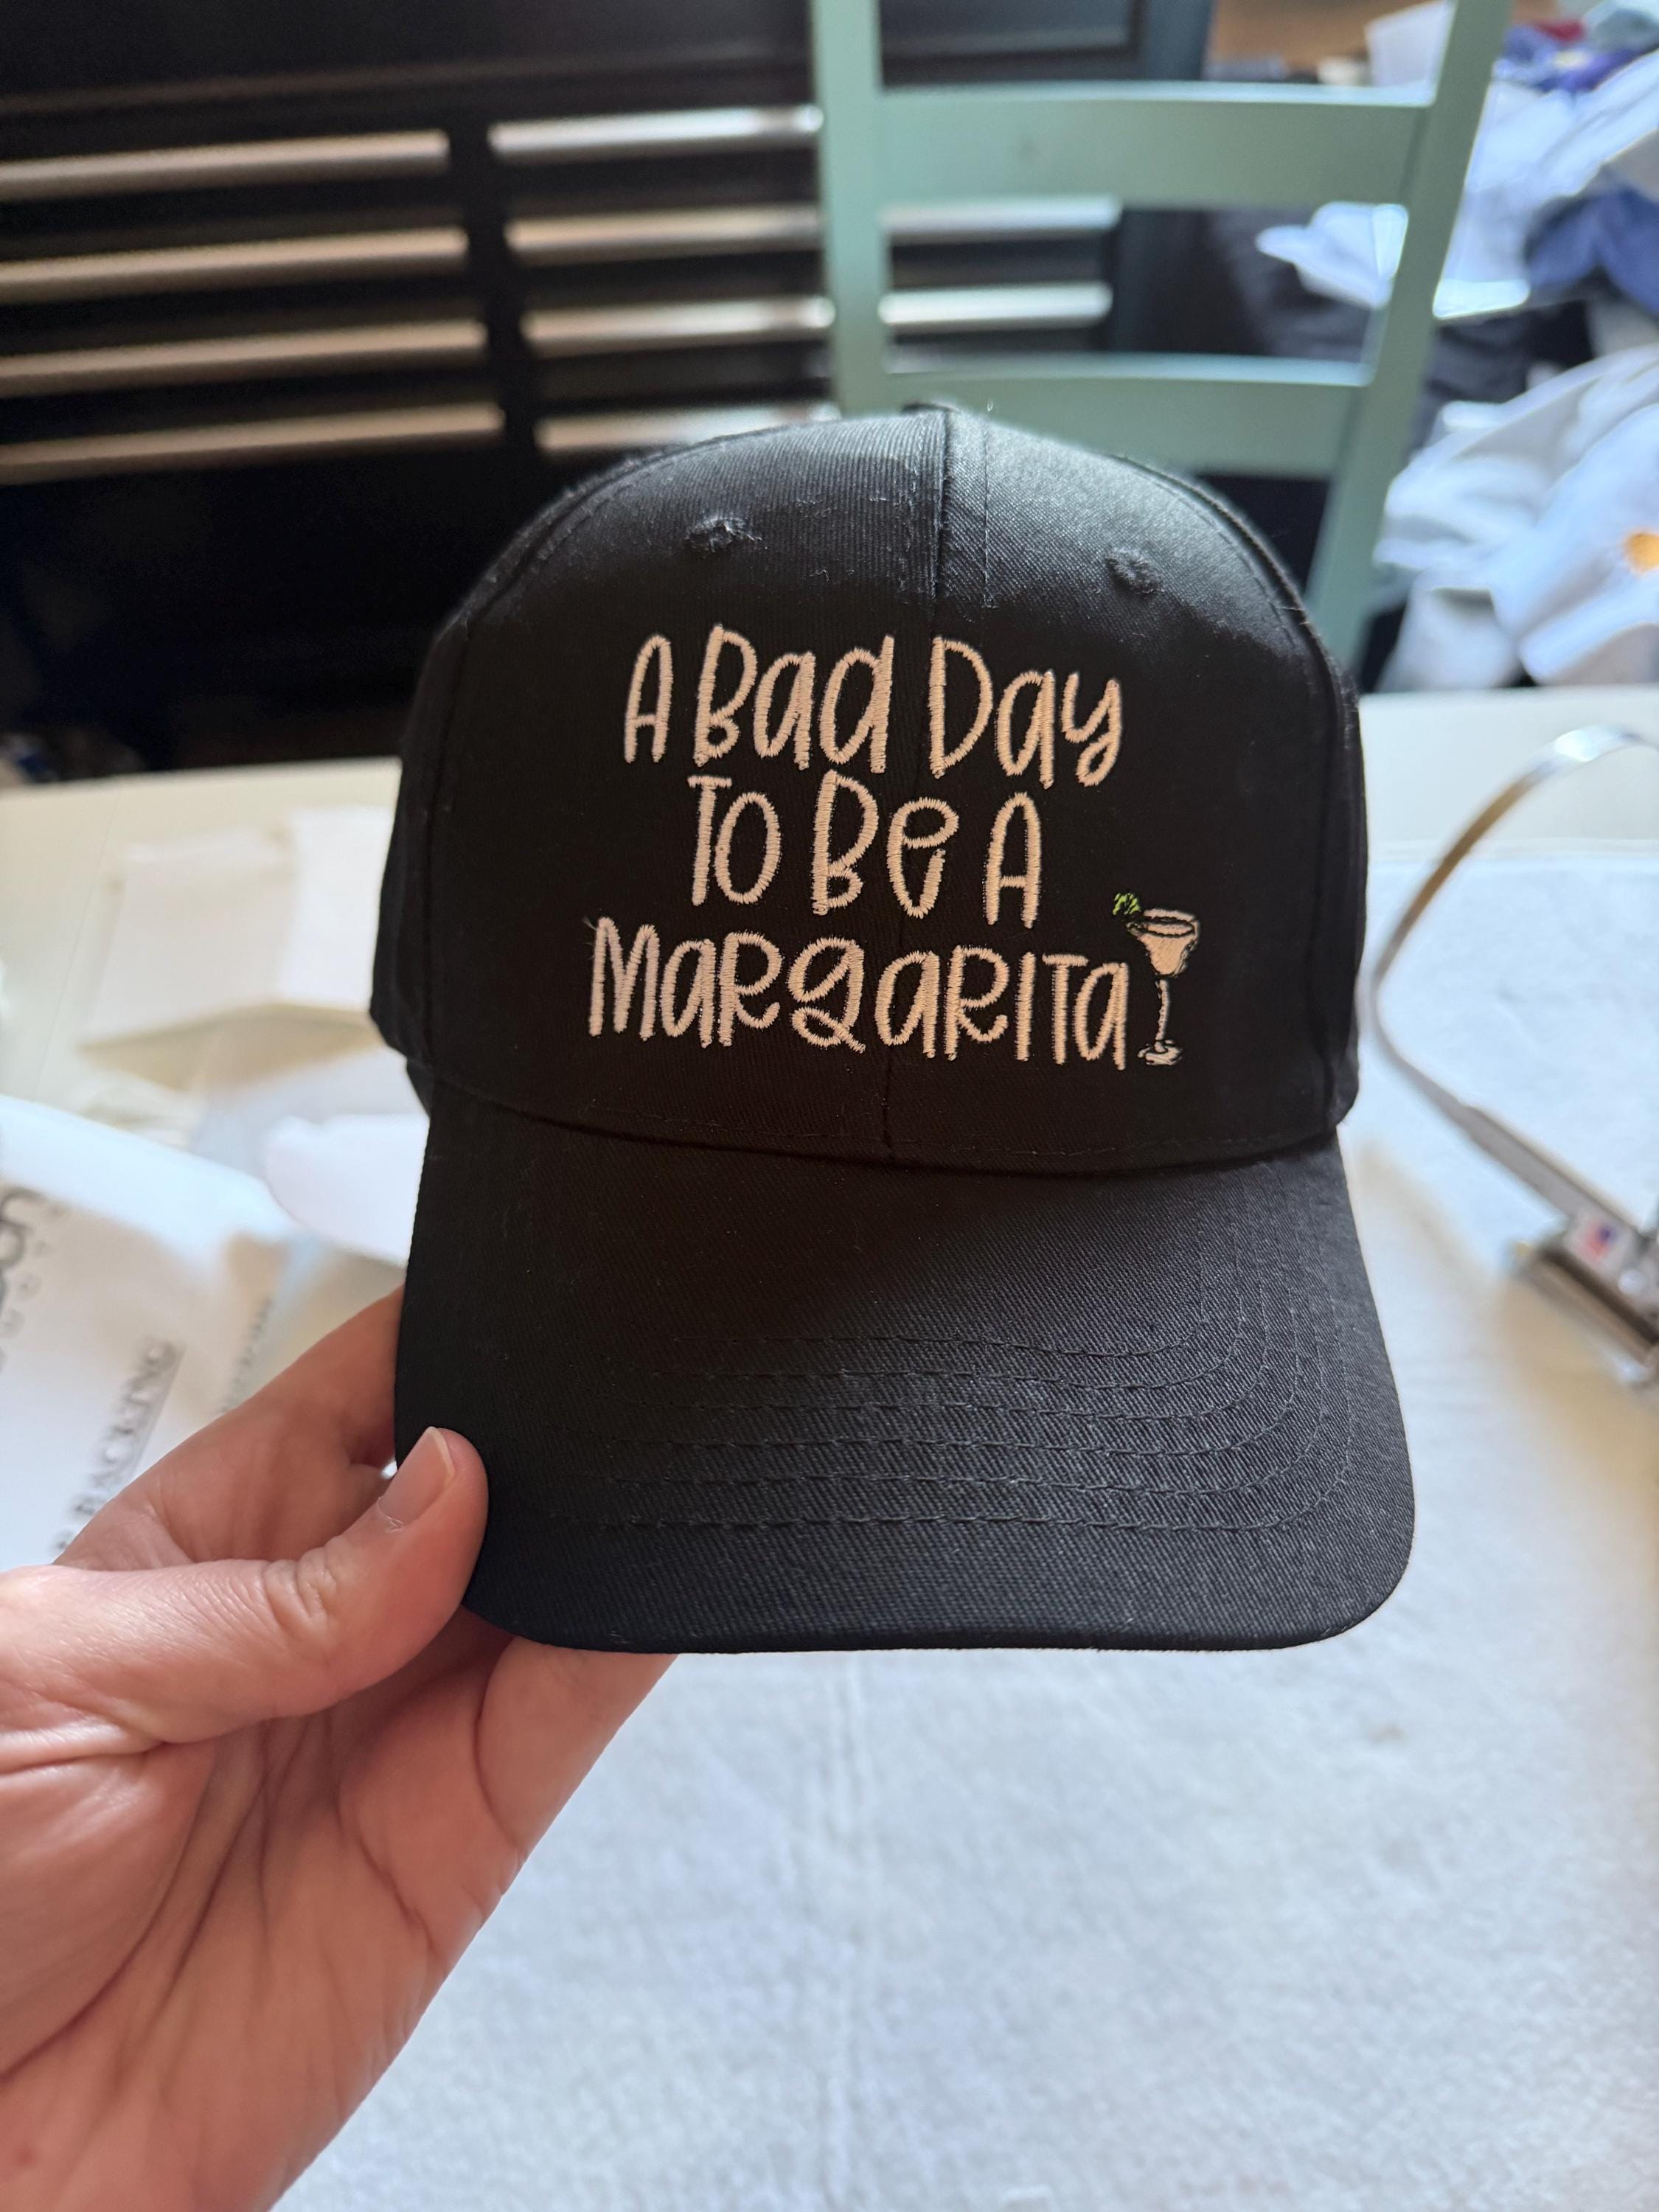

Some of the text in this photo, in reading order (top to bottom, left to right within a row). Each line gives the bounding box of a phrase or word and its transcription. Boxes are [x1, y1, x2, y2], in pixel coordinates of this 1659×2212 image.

[624, 623, 1124, 790] A Bad Day
[811, 768, 961, 920] Be
[985, 792, 1043, 931] A
